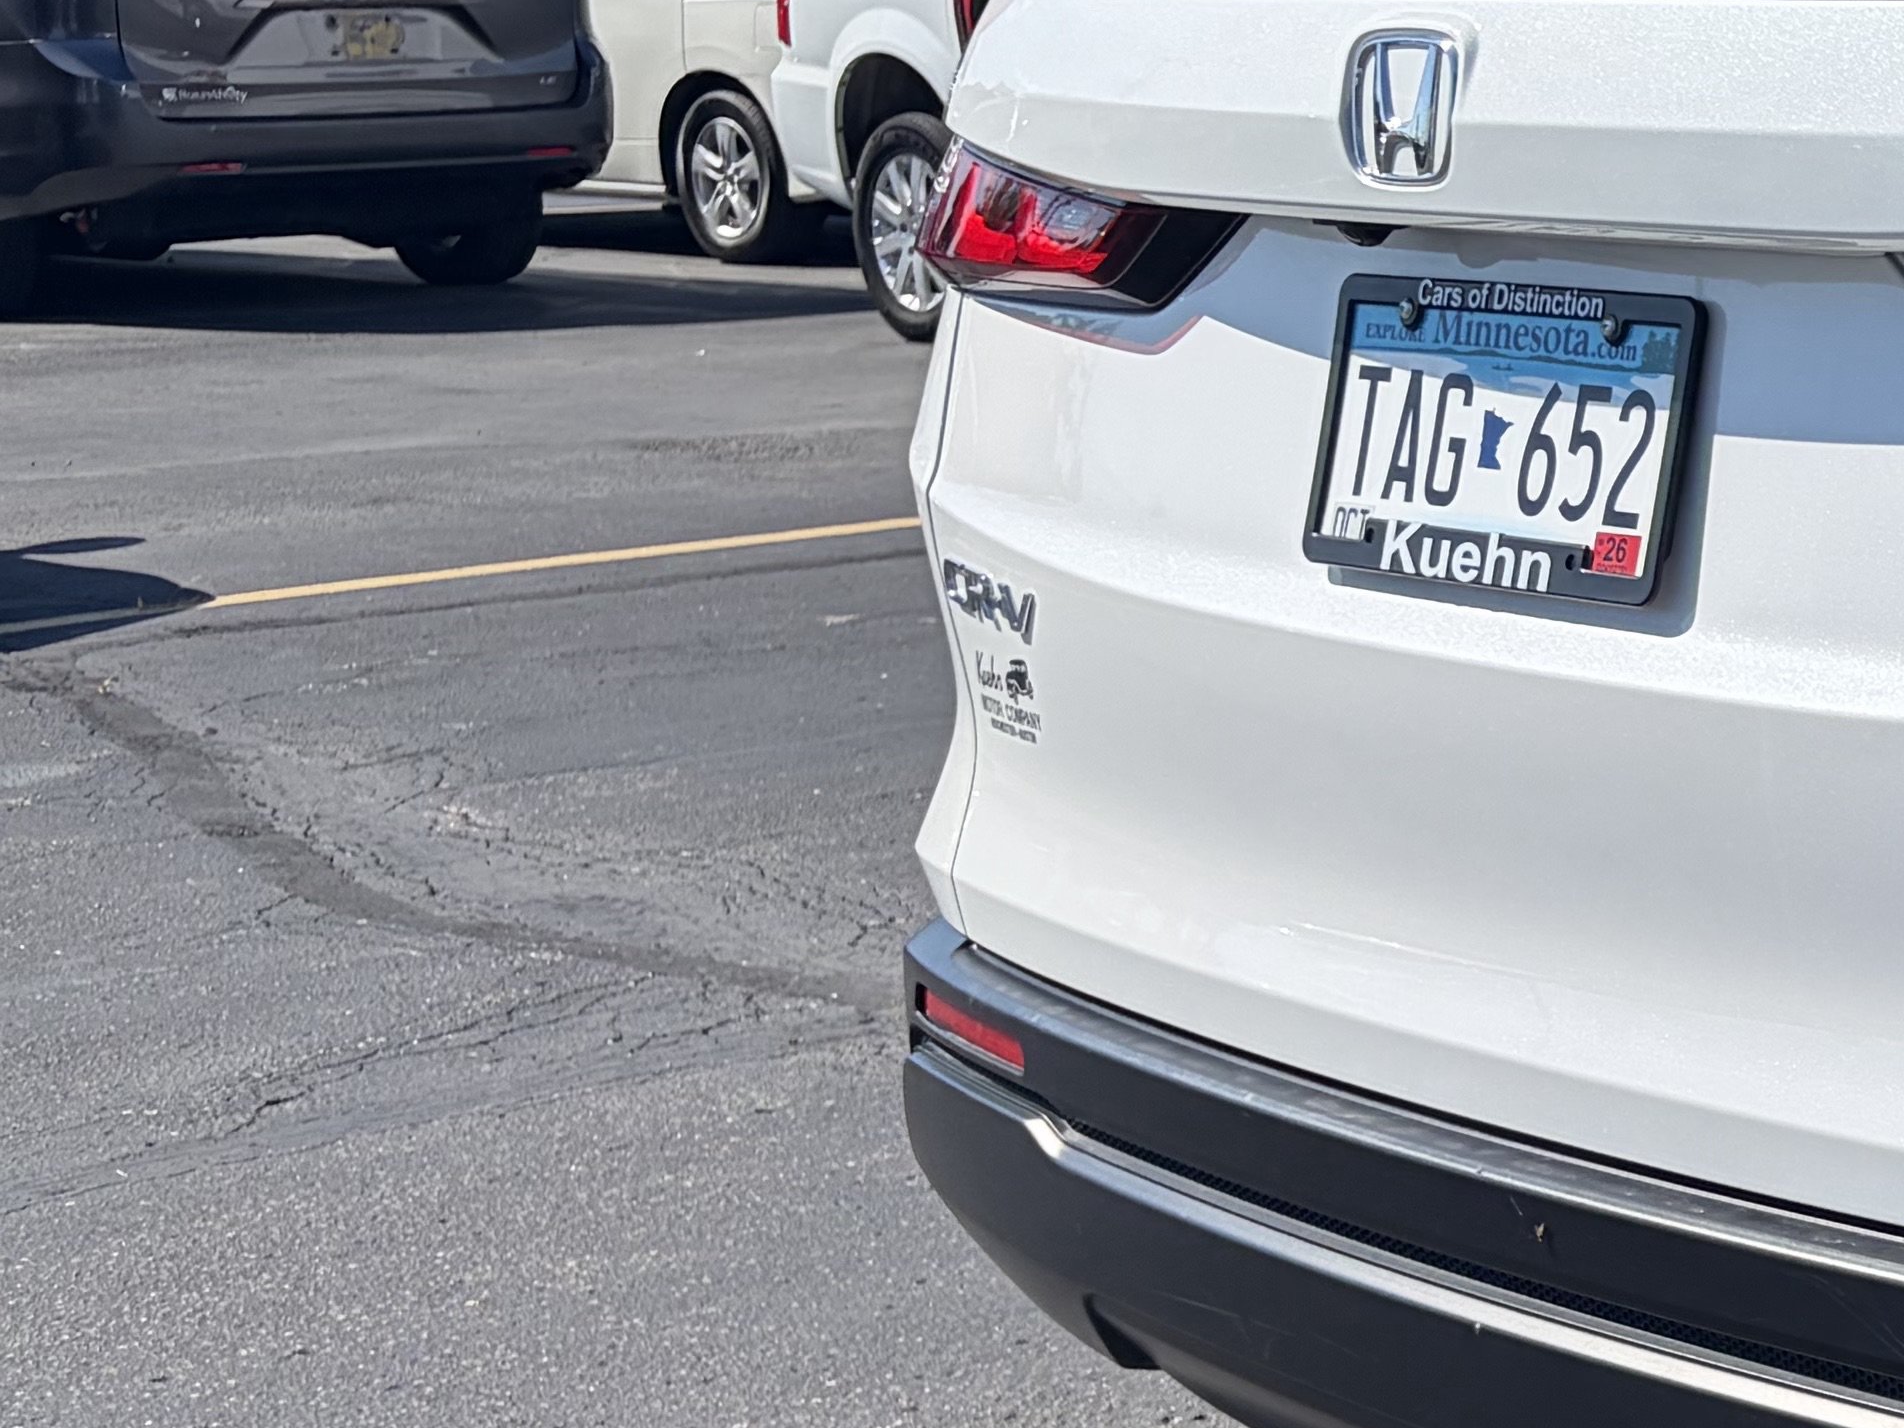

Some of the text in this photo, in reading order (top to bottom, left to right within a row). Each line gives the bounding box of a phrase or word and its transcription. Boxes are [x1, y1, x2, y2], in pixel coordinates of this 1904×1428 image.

[1417, 278, 1604, 318] Cars of Distinction
[1352, 364, 1656, 530] TAG 652
[1380, 519, 1552, 592] Kuehn
[1603, 536, 1628, 563] 26
